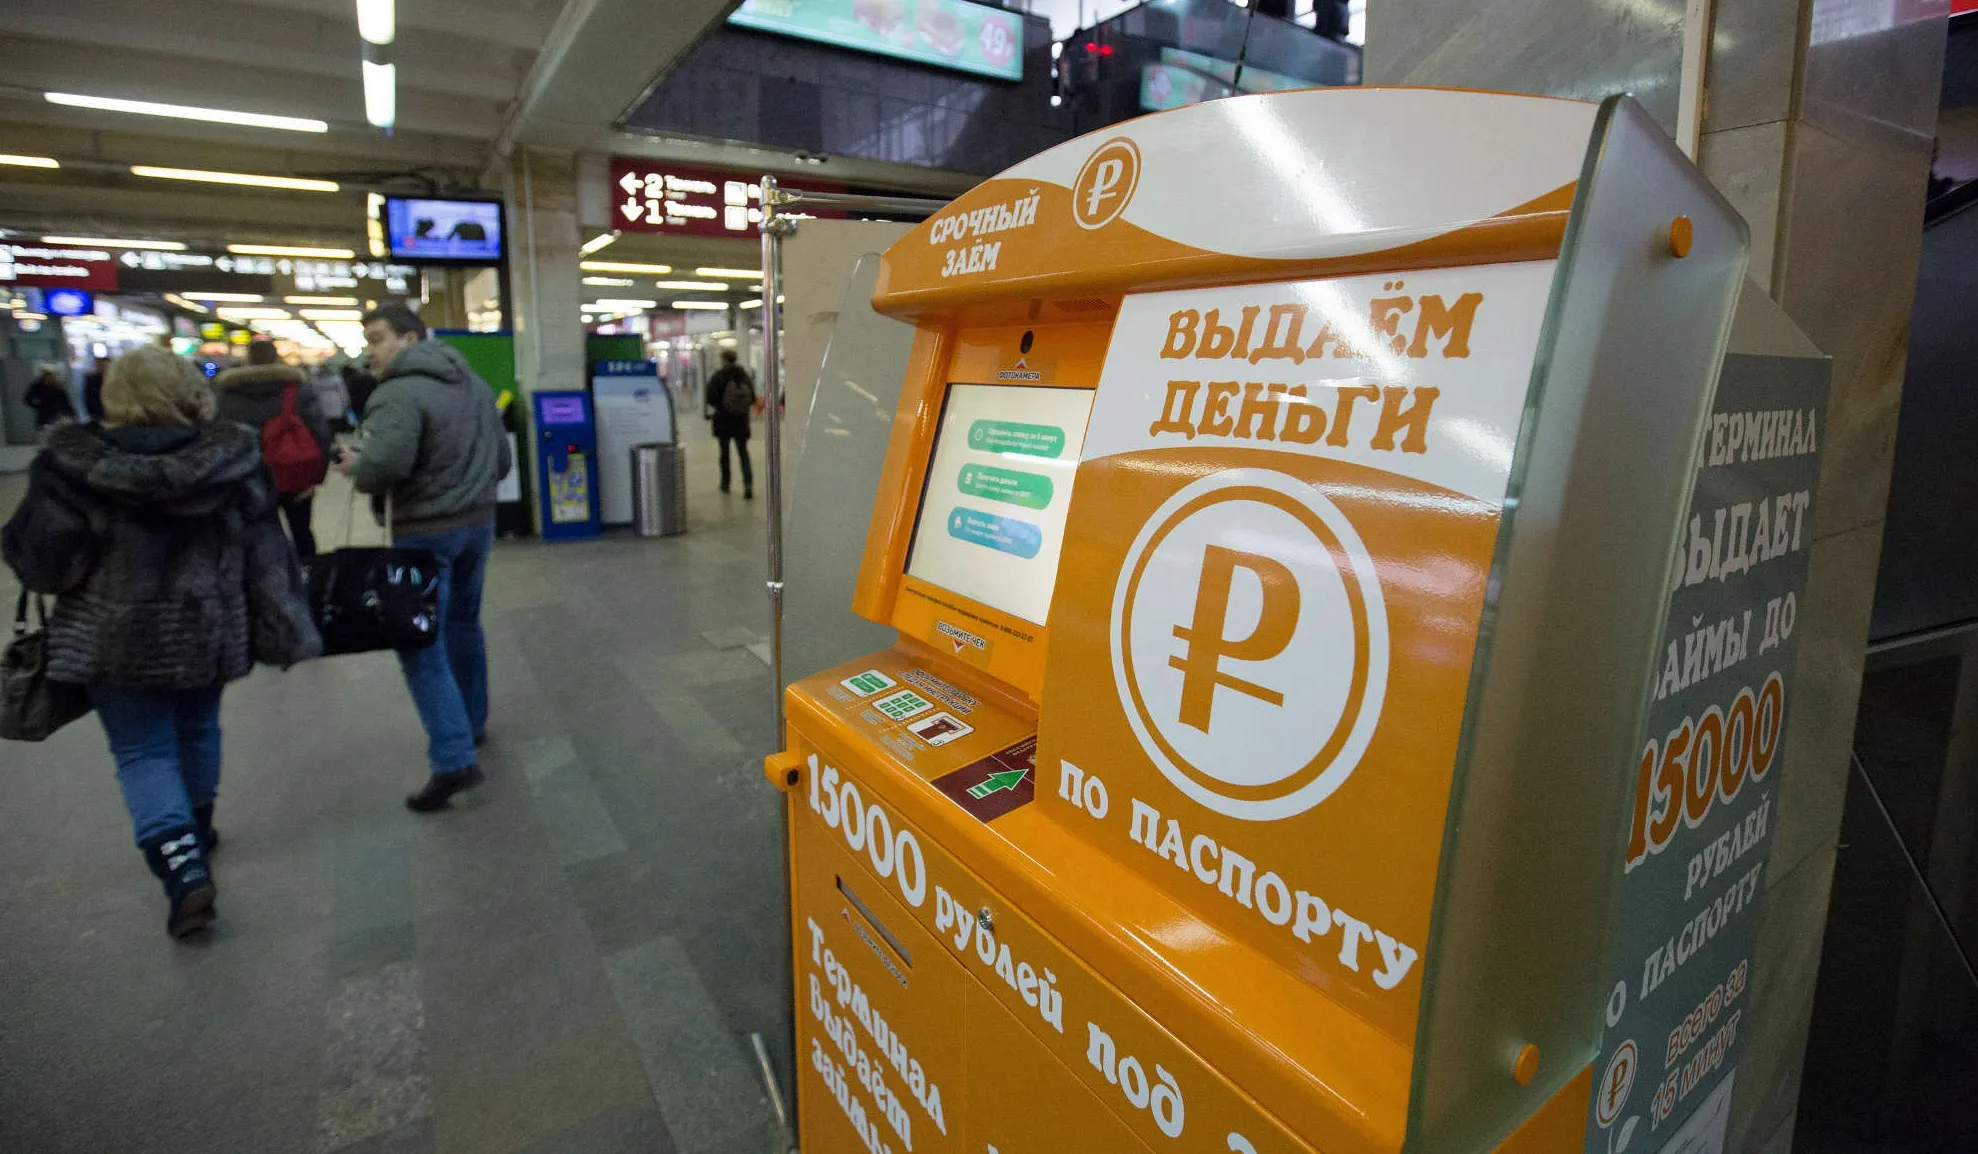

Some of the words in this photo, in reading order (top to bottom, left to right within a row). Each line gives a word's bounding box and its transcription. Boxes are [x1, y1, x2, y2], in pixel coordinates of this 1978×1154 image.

[930, 187, 1040, 245] СРОЧНЫЙ
[941, 238, 1001, 278] ЗАЁМ
[1149, 380, 1440, 454] ДЕНЬГИ
[1652, 612, 1752, 701] АЙМЫ
[1759, 592, 1796, 655] ДО
[1625, 670, 1784, 874] 15000
[1059, 759, 1108, 819] ПО
[1129, 798, 1418, 989] ПАСПОРТУ
[1684, 789, 1771, 901] РУБЛЕЙ
[808, 753, 926, 907] 15000
[1087, 1021, 1185, 1138] под
[1640, 861, 1764, 1000] ПАСПОРТУ
[1651, 1067, 1679, 1132] 15
